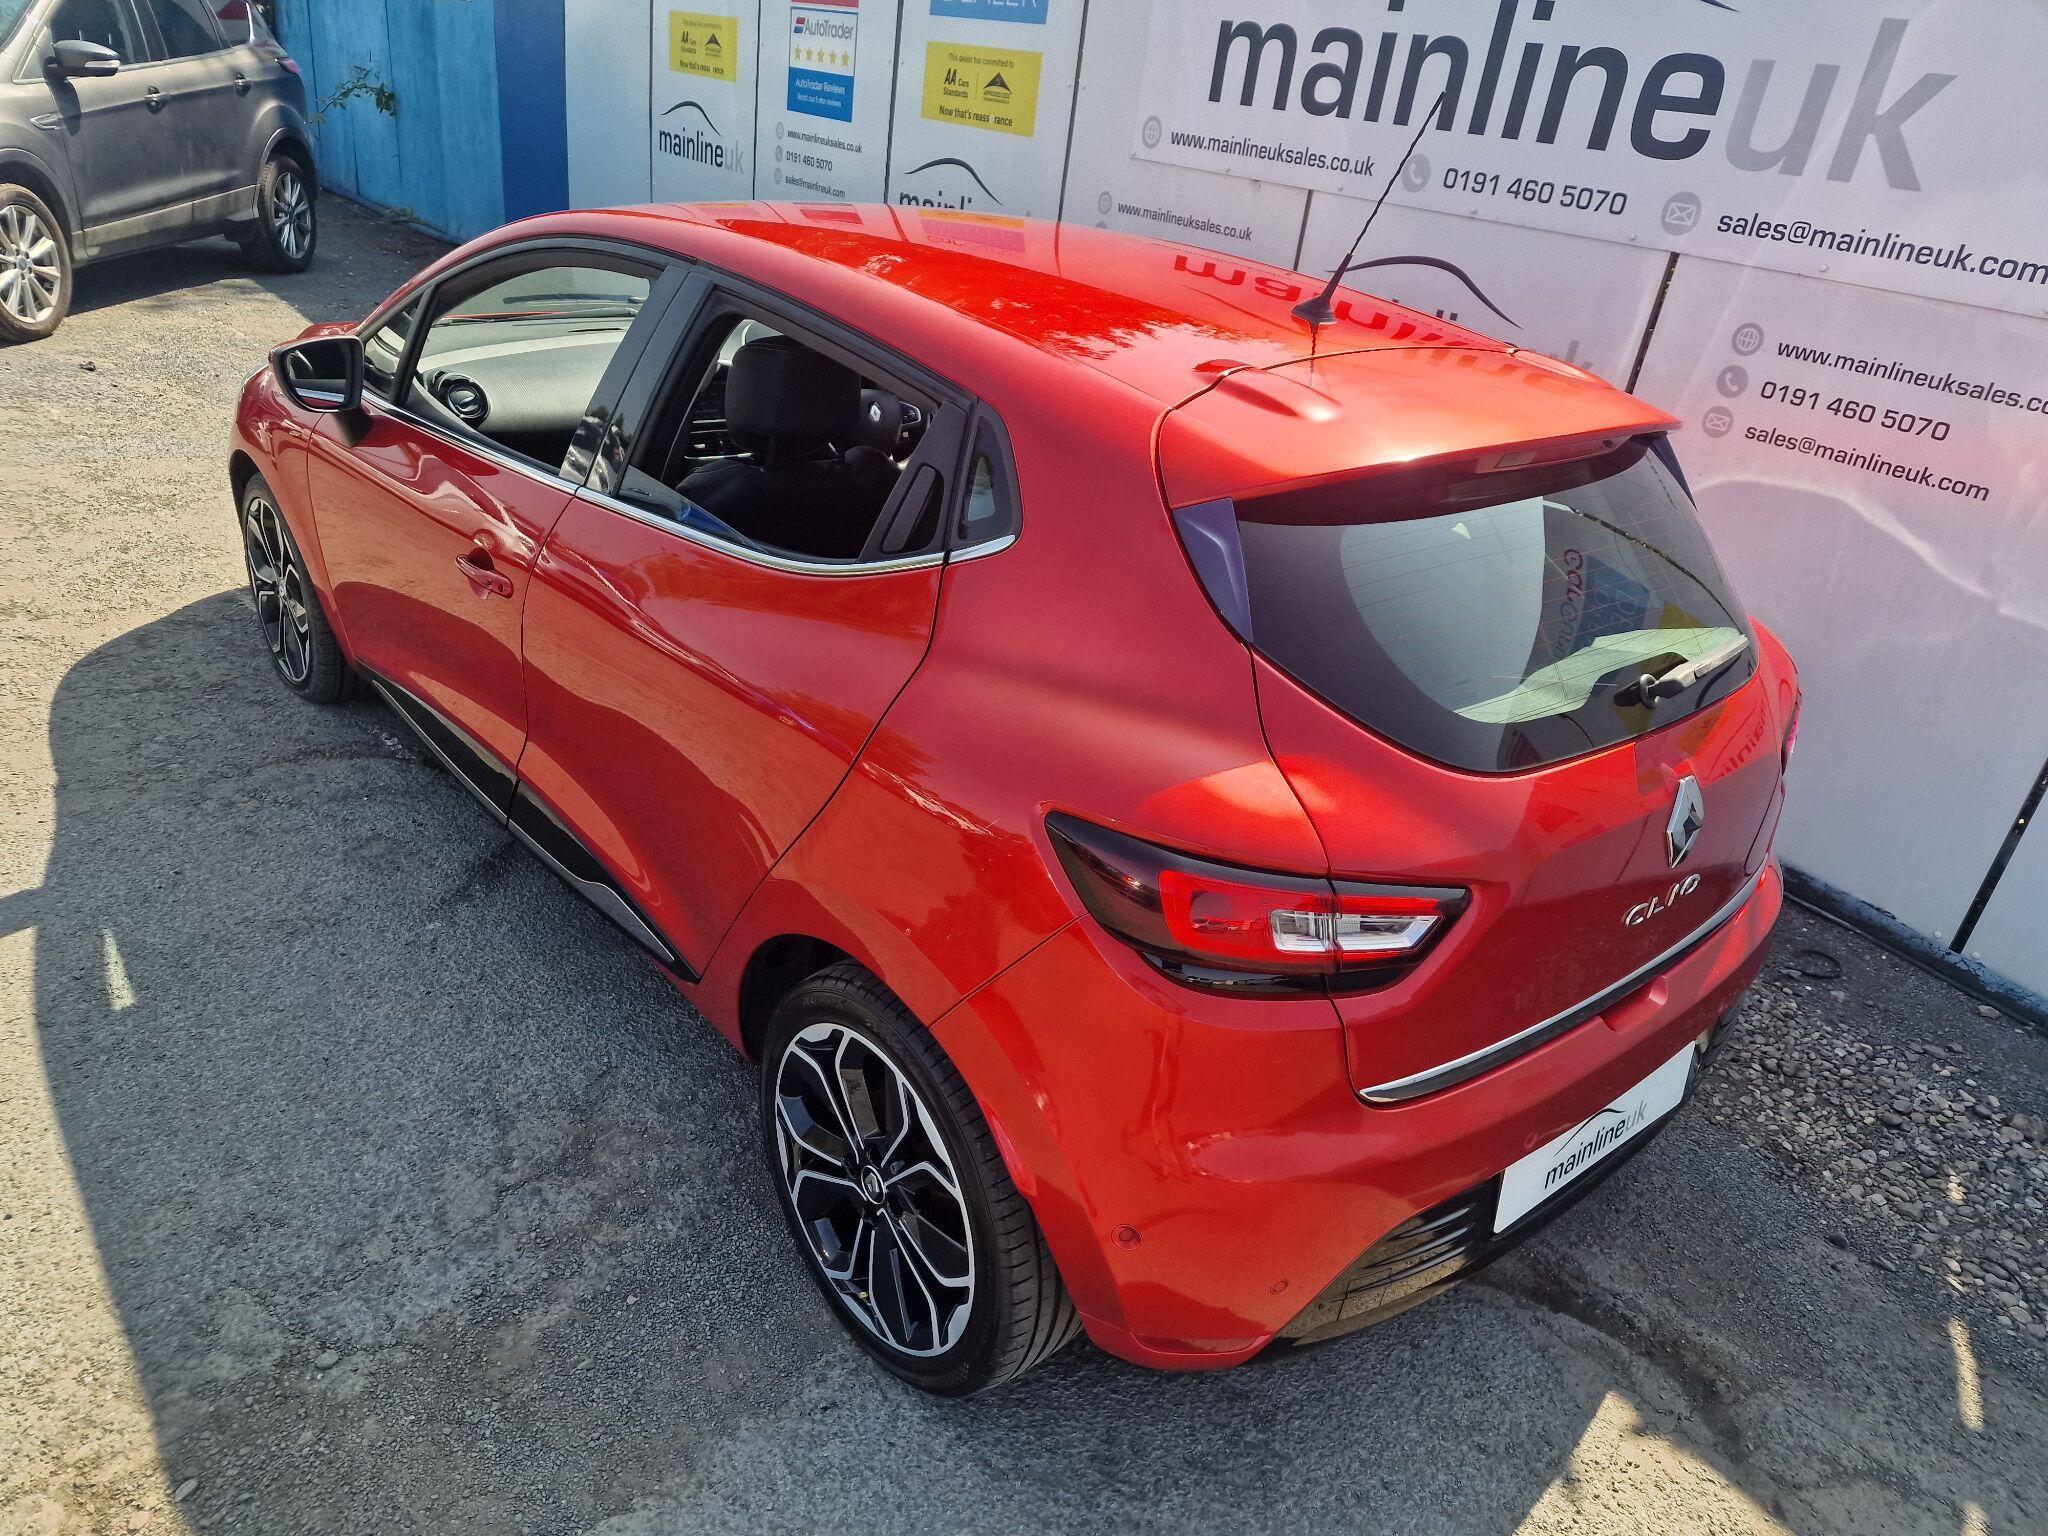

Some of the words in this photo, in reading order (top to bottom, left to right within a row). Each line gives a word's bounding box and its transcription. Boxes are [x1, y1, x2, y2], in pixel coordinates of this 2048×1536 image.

[804, 17, 854, 40] AutoTrader
[795, 78, 823, 91] AutoTrader
[823, 82, 846, 95] Reviews
[943, 87, 969, 99] Standards
[944, 67, 957, 85] AA
[958, 79, 969, 88] Cars
[1208, 0, 1959, 193] mainlineuk
[940, 105, 953, 117] Now
[954, 107, 971, 120] that's
[659, 127, 744, 174] mainlineuk
[786, 150, 801, 164] 0191
[802, 155, 815, 167] 460
[816, 157, 833, 171] 5070
[787, 130, 863, 153] www.mainlineuksales.co.uk
[1170, 130, 1375, 177] www.mainlineuksales.co.uk
[785, 175, 846, 198] sales@mainlineuk.com
[1443, 167, 1501, 196] 0191
[1507, 178, 1555, 204] 460
[1560, 184, 1628, 215] 5070
[1117, 202, 1253, 241] www.mainlineuksales.co.uk
[1717, 212, 2048, 285] sales@mainlineuk.com
[1760, 381, 1821, 410] 0191
[1827, 397, 1877, 423] 460
[1881, 409, 1951, 441] 5070
[1744, 426, 1990, 501] sales@mainlineuk.com
[1622, 873, 1701, 927] CLIO
[1544, 1100, 1649, 1190] mainlineuk
